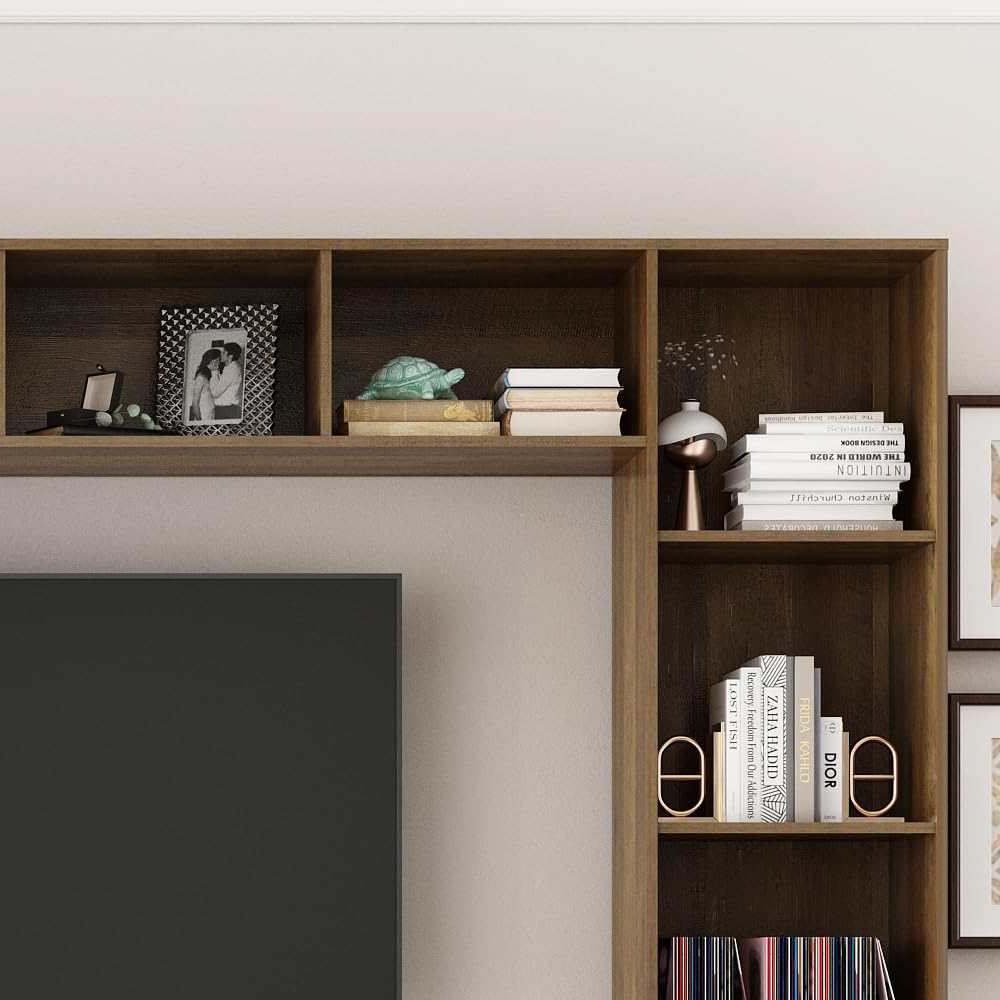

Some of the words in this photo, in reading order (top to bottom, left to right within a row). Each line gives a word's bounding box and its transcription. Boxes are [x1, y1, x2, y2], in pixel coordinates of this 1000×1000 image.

[837, 464, 906, 476] INTUITION
[748, 710, 757, 742] Freedom
[768, 696, 778, 731] ZAHA
[800, 697, 810, 733] FRIDA
[748, 744, 756, 762] From
[768, 736, 778, 779] HADID
[800, 742, 810, 783] KAHLO
[825, 753, 837, 788] DIOR
[748, 764, 756, 778] Our
[748, 781, 757, 819] Addictions
